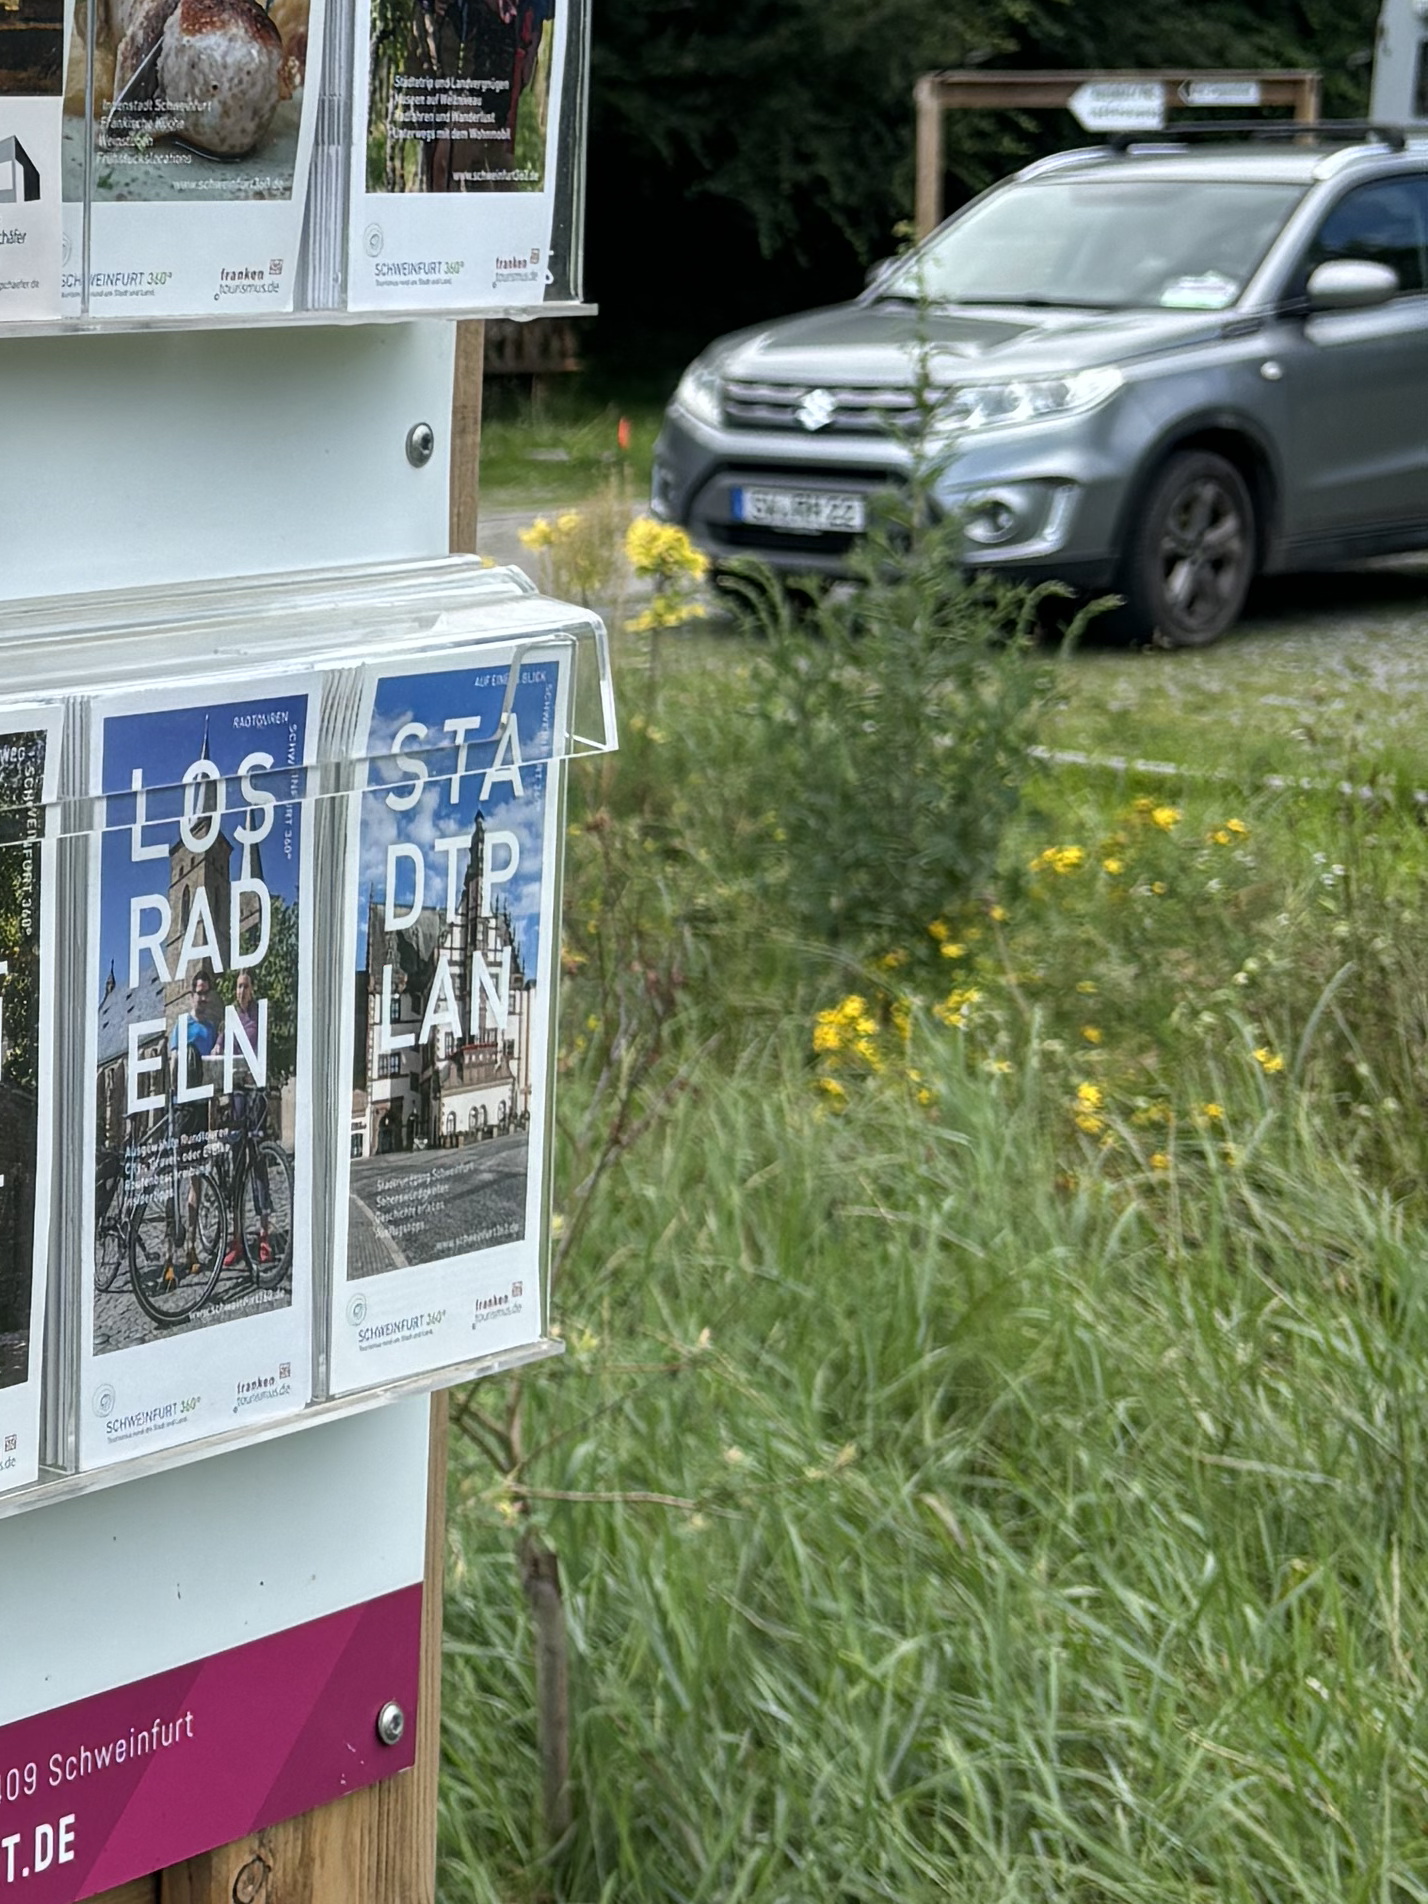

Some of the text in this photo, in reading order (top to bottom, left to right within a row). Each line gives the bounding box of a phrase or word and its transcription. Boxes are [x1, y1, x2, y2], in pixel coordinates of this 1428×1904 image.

[131, 752, 277, 862] LOS
[385, 712, 524, 812] STA
[129, 877, 271, 989] RAD
[384, 830, 520, 933] DTP
[380, 946, 512, 1052] LAN
[126, 998, 268, 1115] ELN
[48, 1710, 196, 1788] Schweinfurt
